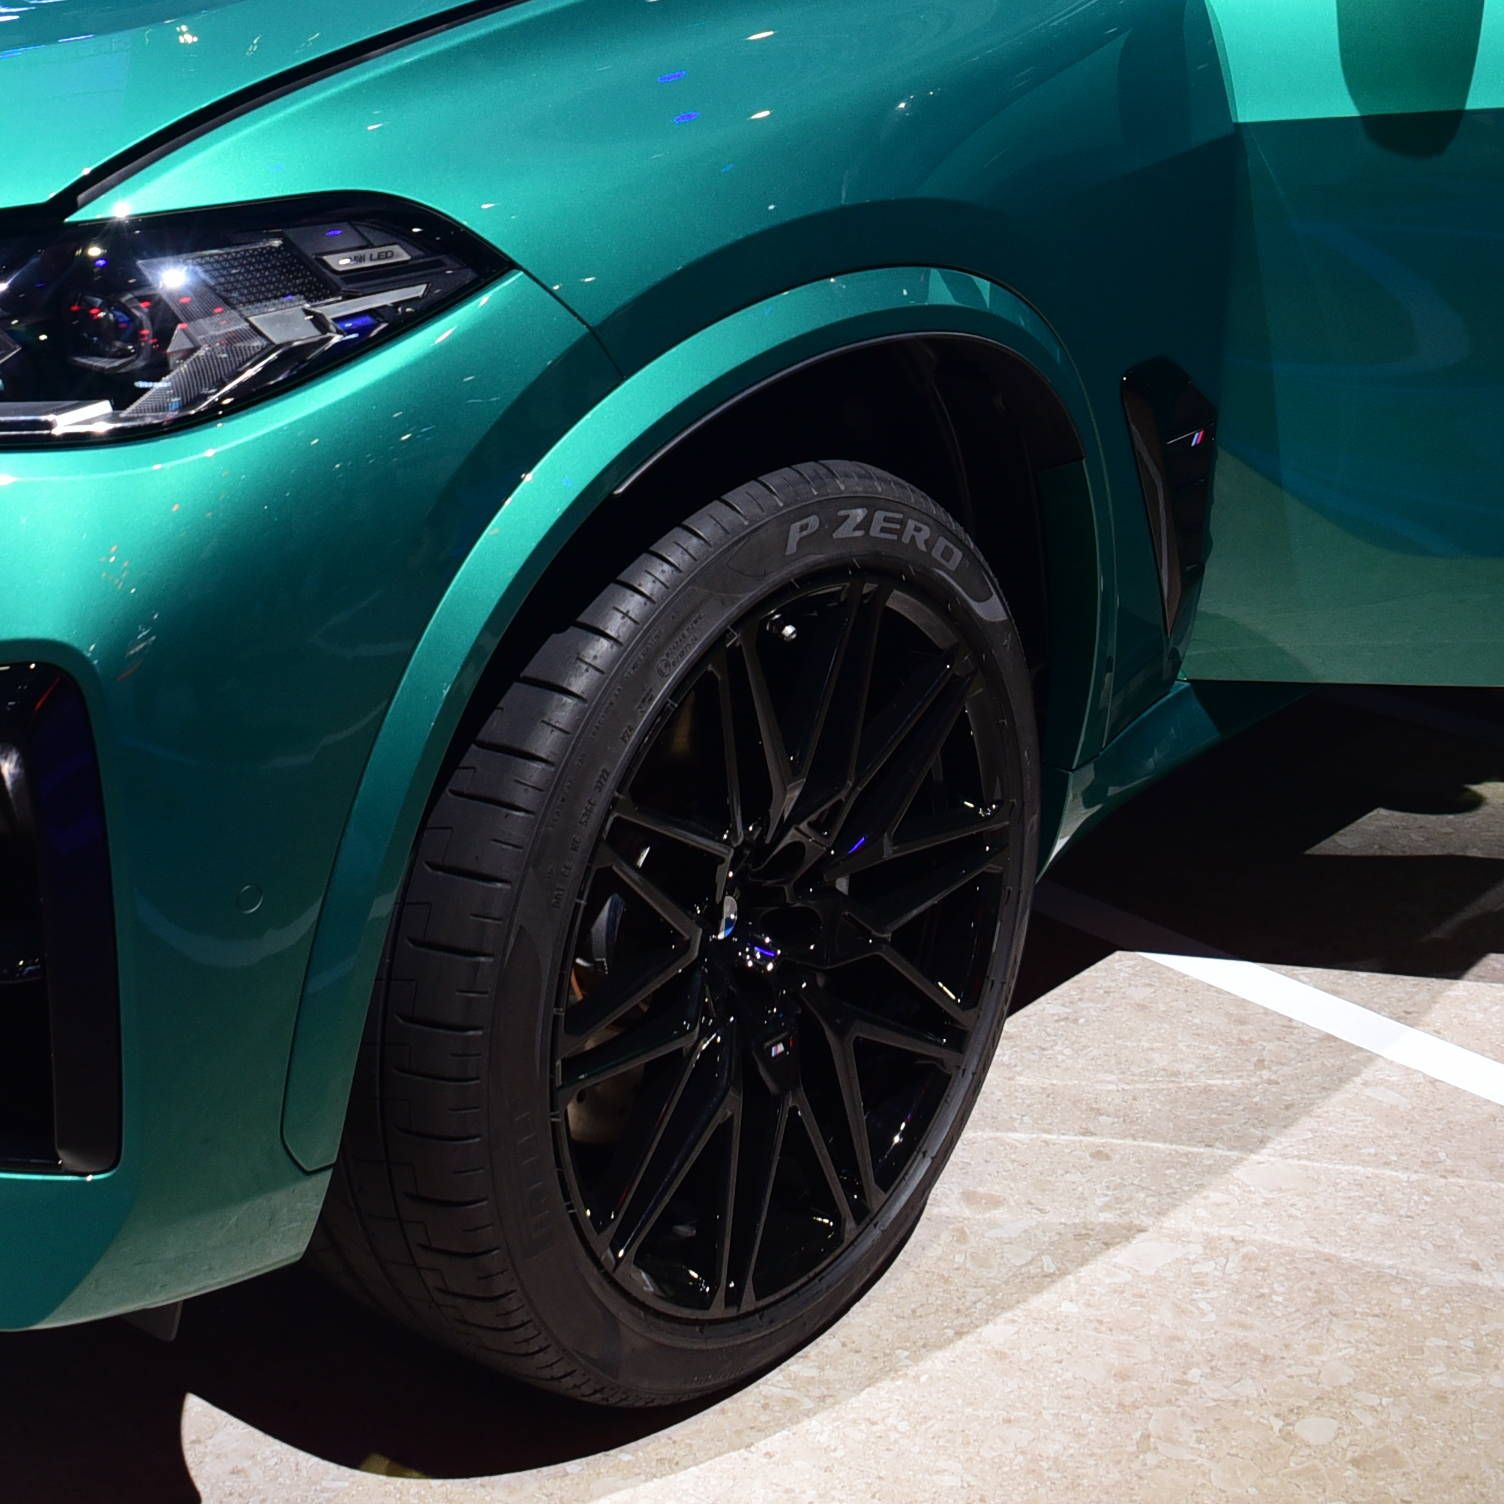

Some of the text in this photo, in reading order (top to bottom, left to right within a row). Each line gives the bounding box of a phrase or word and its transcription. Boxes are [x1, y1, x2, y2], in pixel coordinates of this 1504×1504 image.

[369, 249, 394, 262] LED
[785, 507, 963, 572] P ZERO
